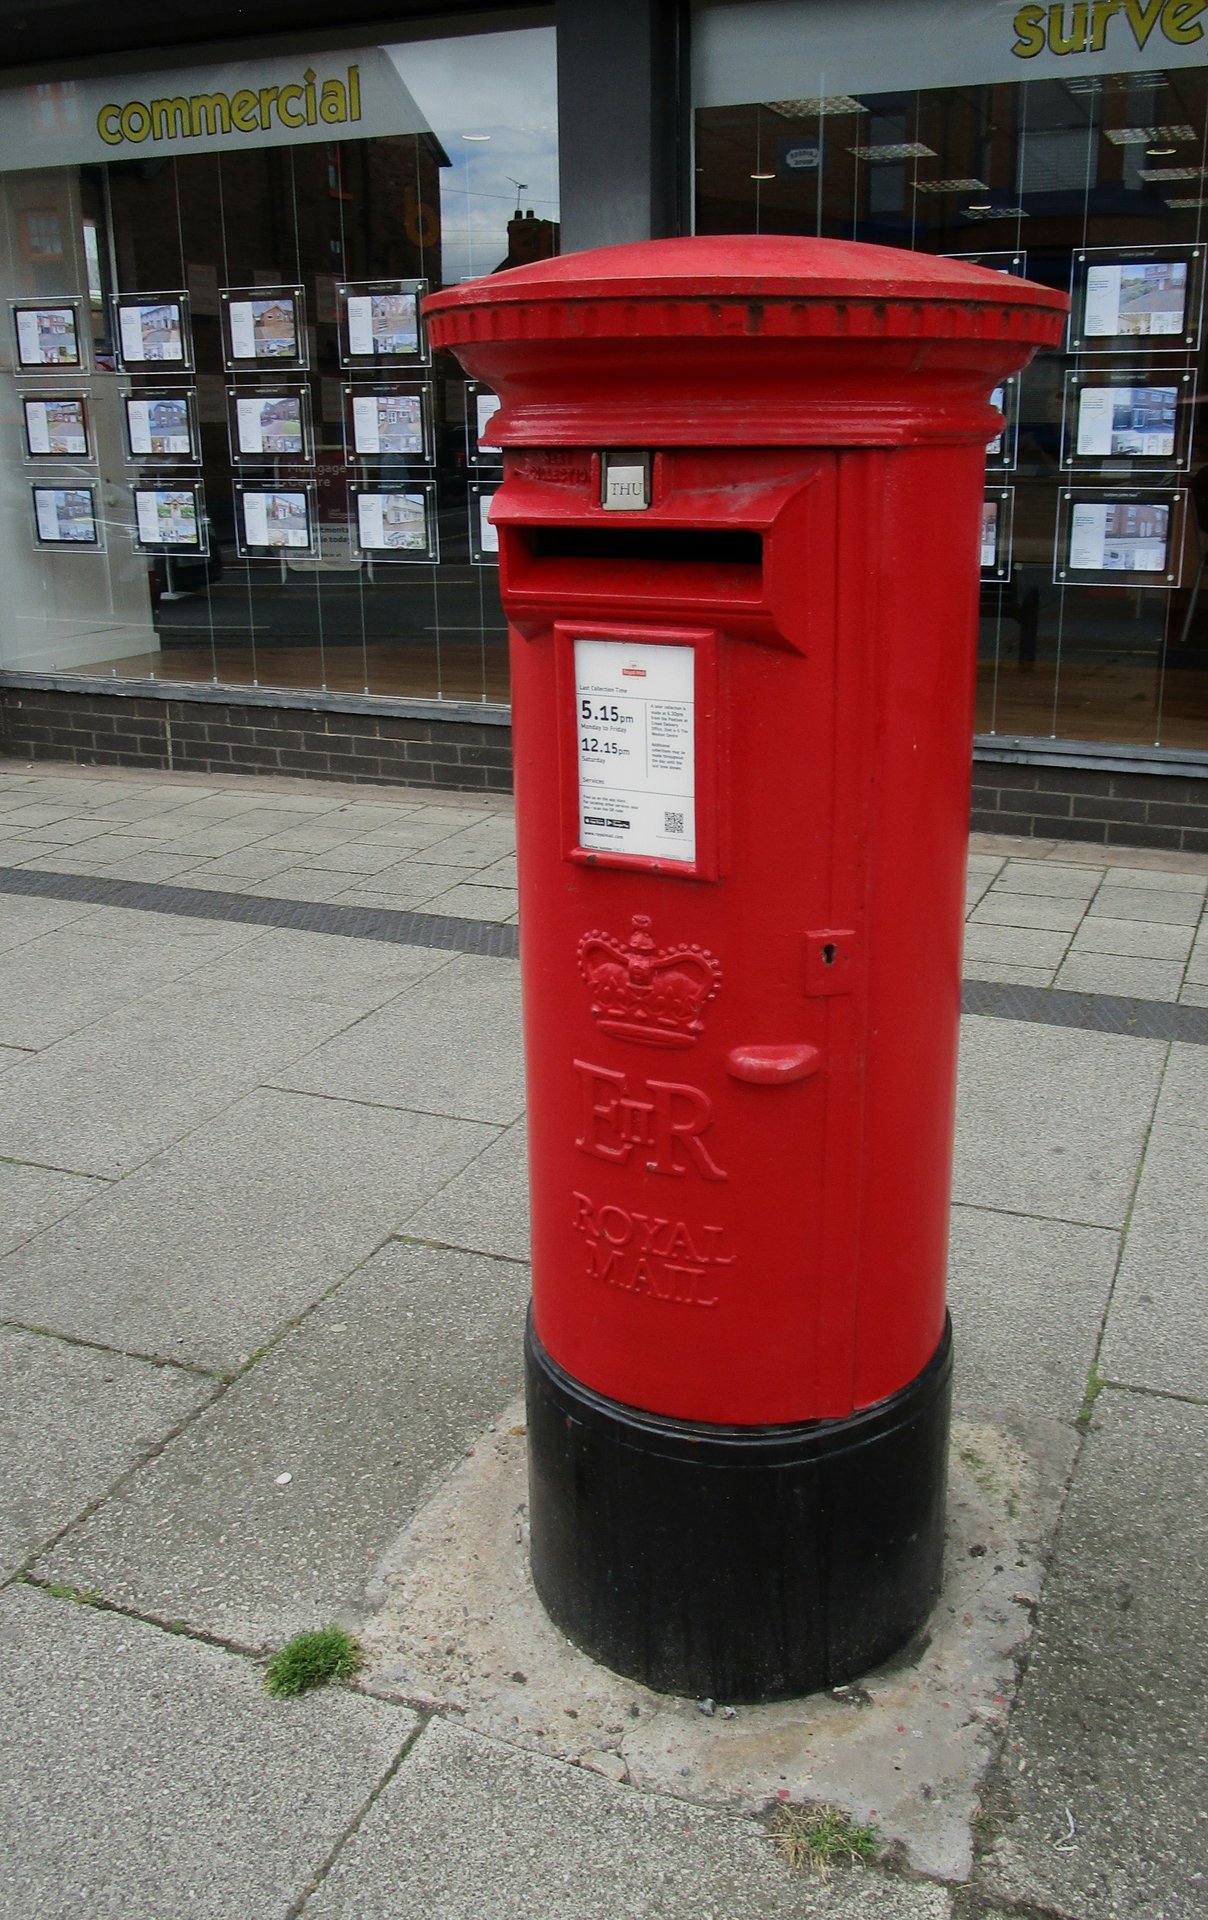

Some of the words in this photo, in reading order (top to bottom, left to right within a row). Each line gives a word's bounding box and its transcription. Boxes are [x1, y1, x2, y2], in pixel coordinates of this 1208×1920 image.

[97, 64, 361, 146] commercial
[610, 482, 643, 496] THU
[581, 723, 601, 731] Monday
[610, 726, 627, 734] Friday
[581, 756, 606, 764] Saturday
[582, 777, 605, 785] Services
[572, 1191, 738, 1265] ROYAL
[585, 1239, 719, 1306] MAIL
